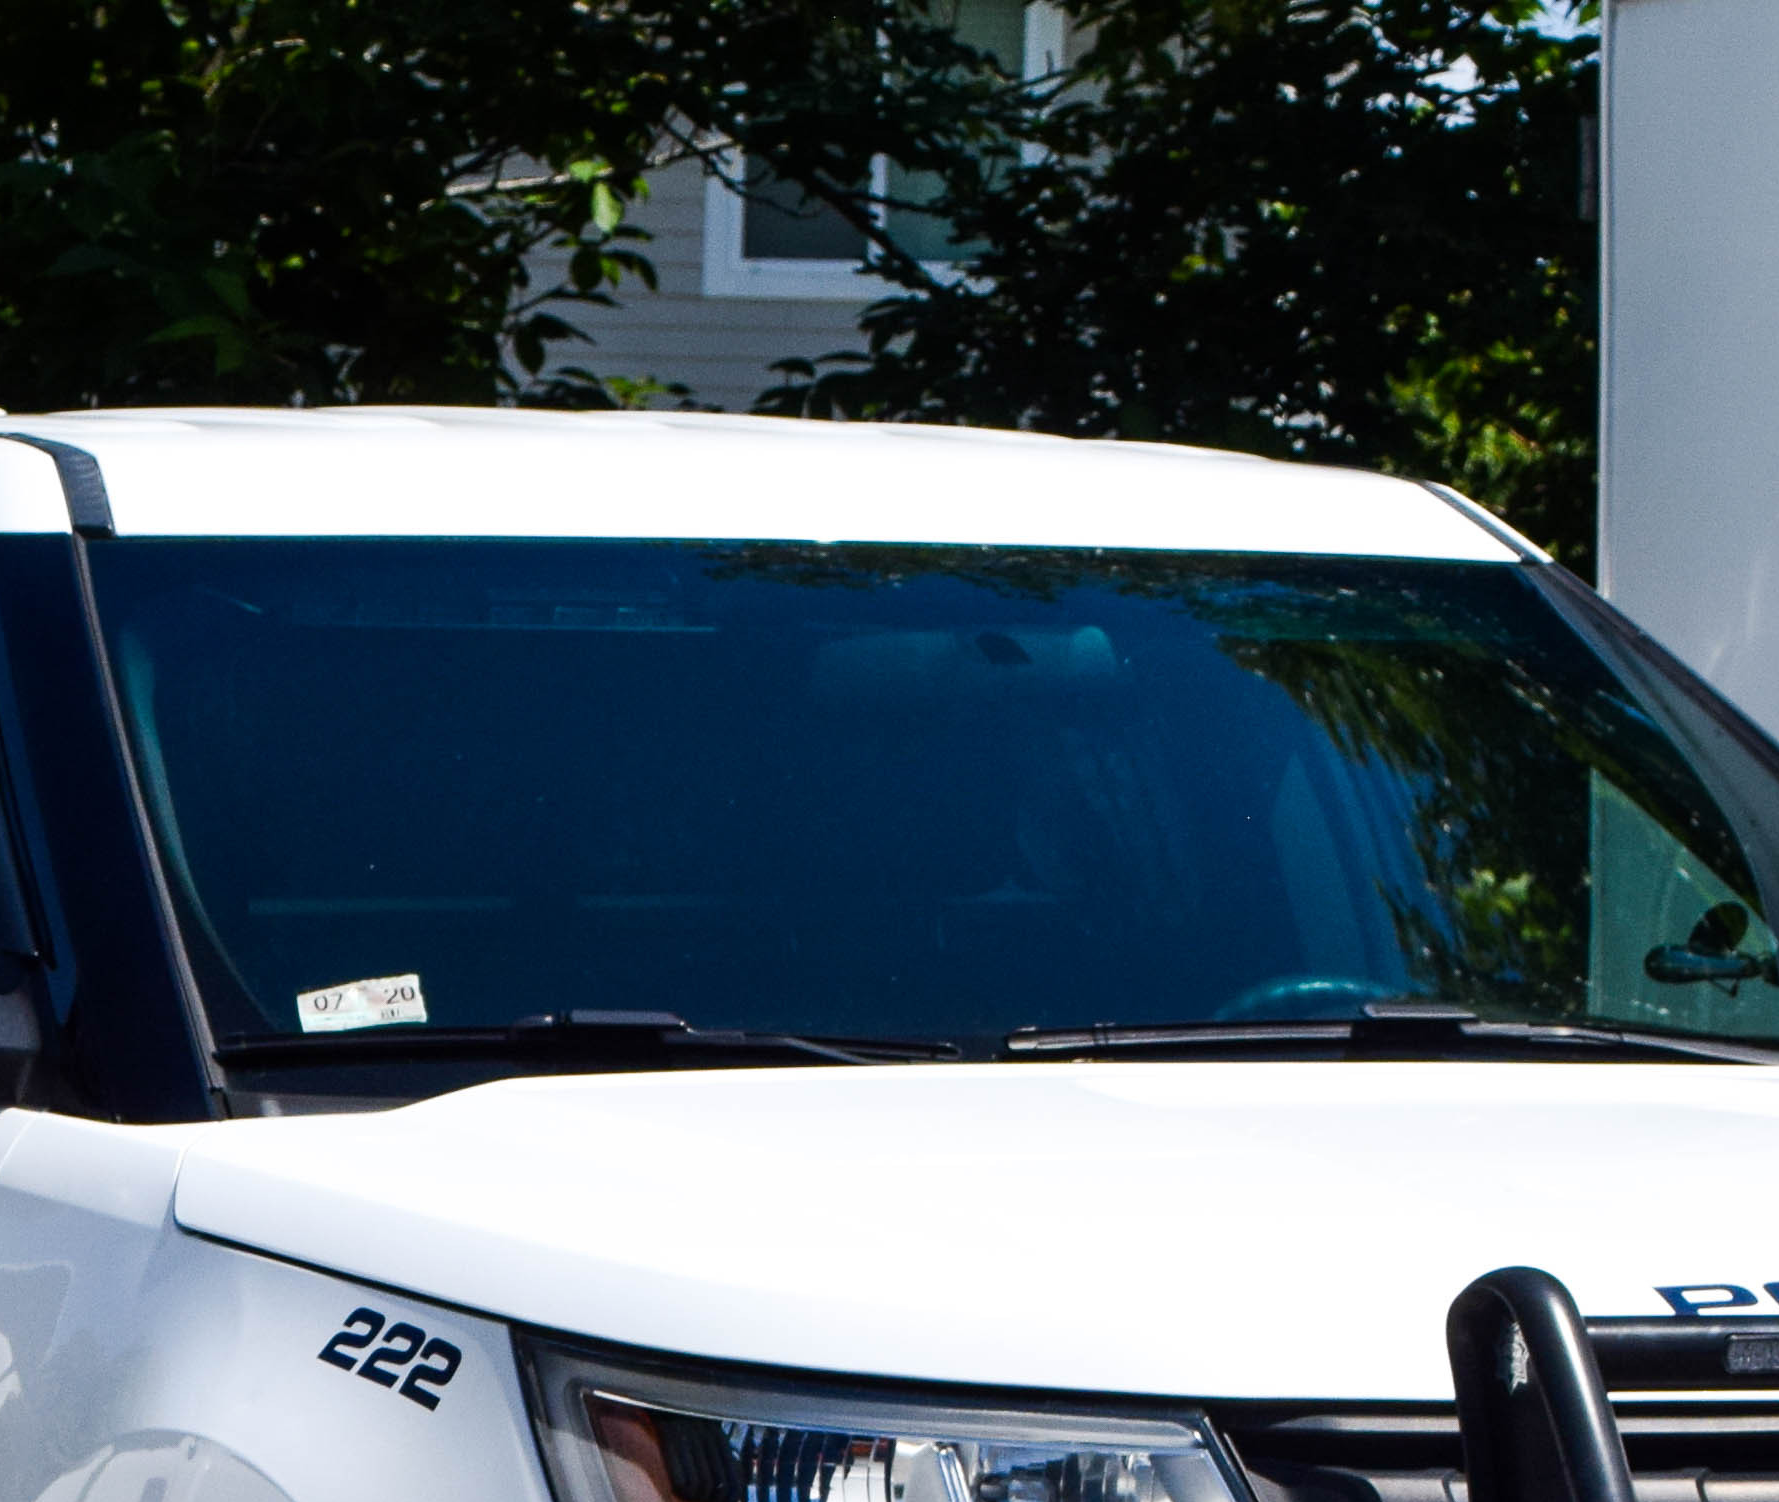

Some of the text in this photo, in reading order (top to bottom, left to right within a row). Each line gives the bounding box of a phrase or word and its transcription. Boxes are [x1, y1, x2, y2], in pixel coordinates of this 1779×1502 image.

[313, 985, 416, 1012] 07 20
[317, 1306, 462, 1412] 222
